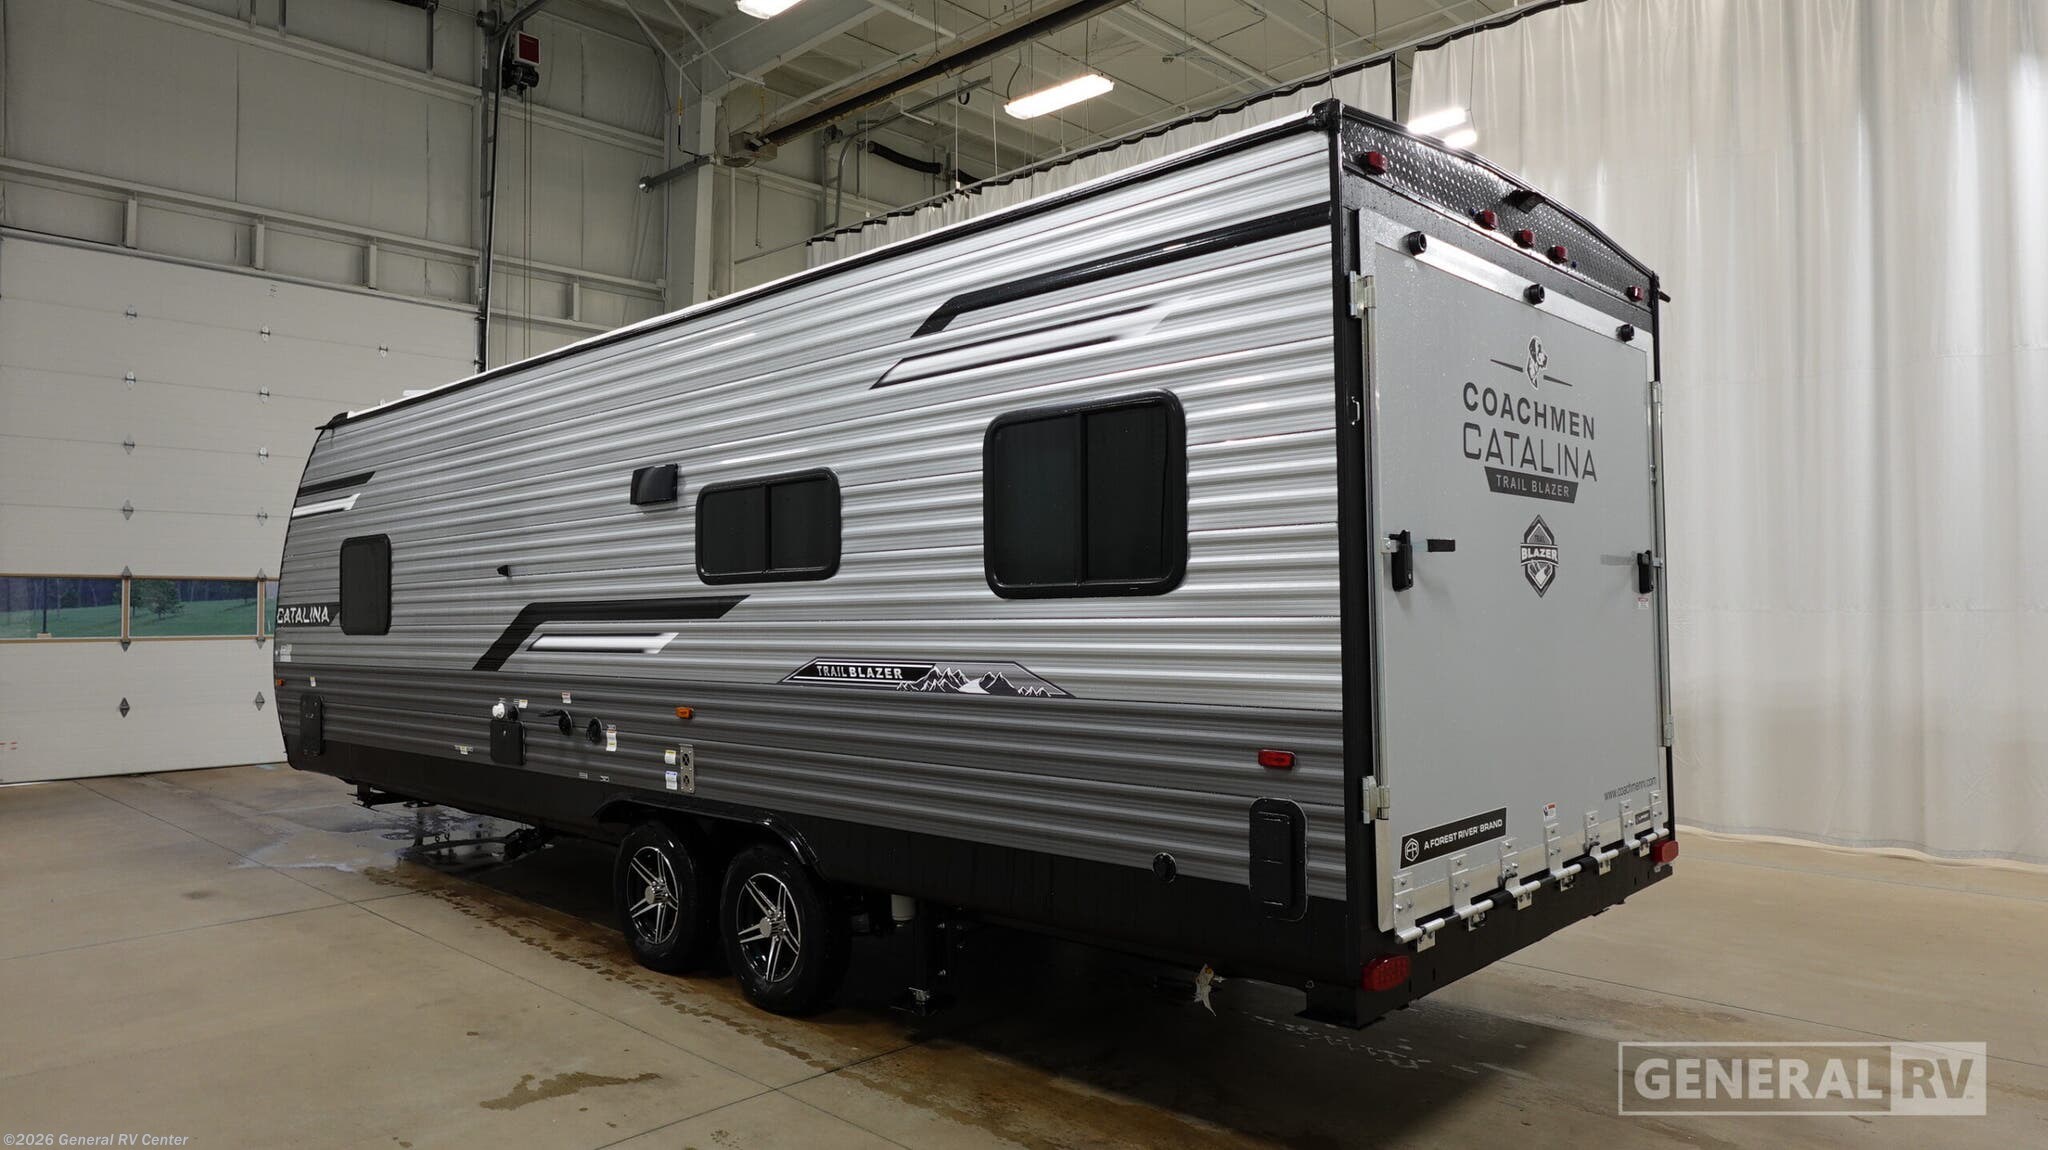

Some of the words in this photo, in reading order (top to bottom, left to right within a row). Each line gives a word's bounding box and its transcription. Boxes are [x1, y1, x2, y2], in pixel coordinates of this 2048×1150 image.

[1463, 382, 1594, 440] COACHMEN
[1463, 422, 1598, 482] CATALINA
[1496, 475, 1527, 491] TRAIL
[1532, 481, 1569, 497] BLAZER
[1521, 547, 1558, 562] BLAZER
[276, 605, 330, 624] CATALINA
[816, 665, 847, 677] TRAIL
[848, 666, 903, 679] BLAZER
[1423, 841, 1430, 850] A
[1430, 832, 1458, 848] FOREST
[1480, 819, 1503, 832] BRAND
